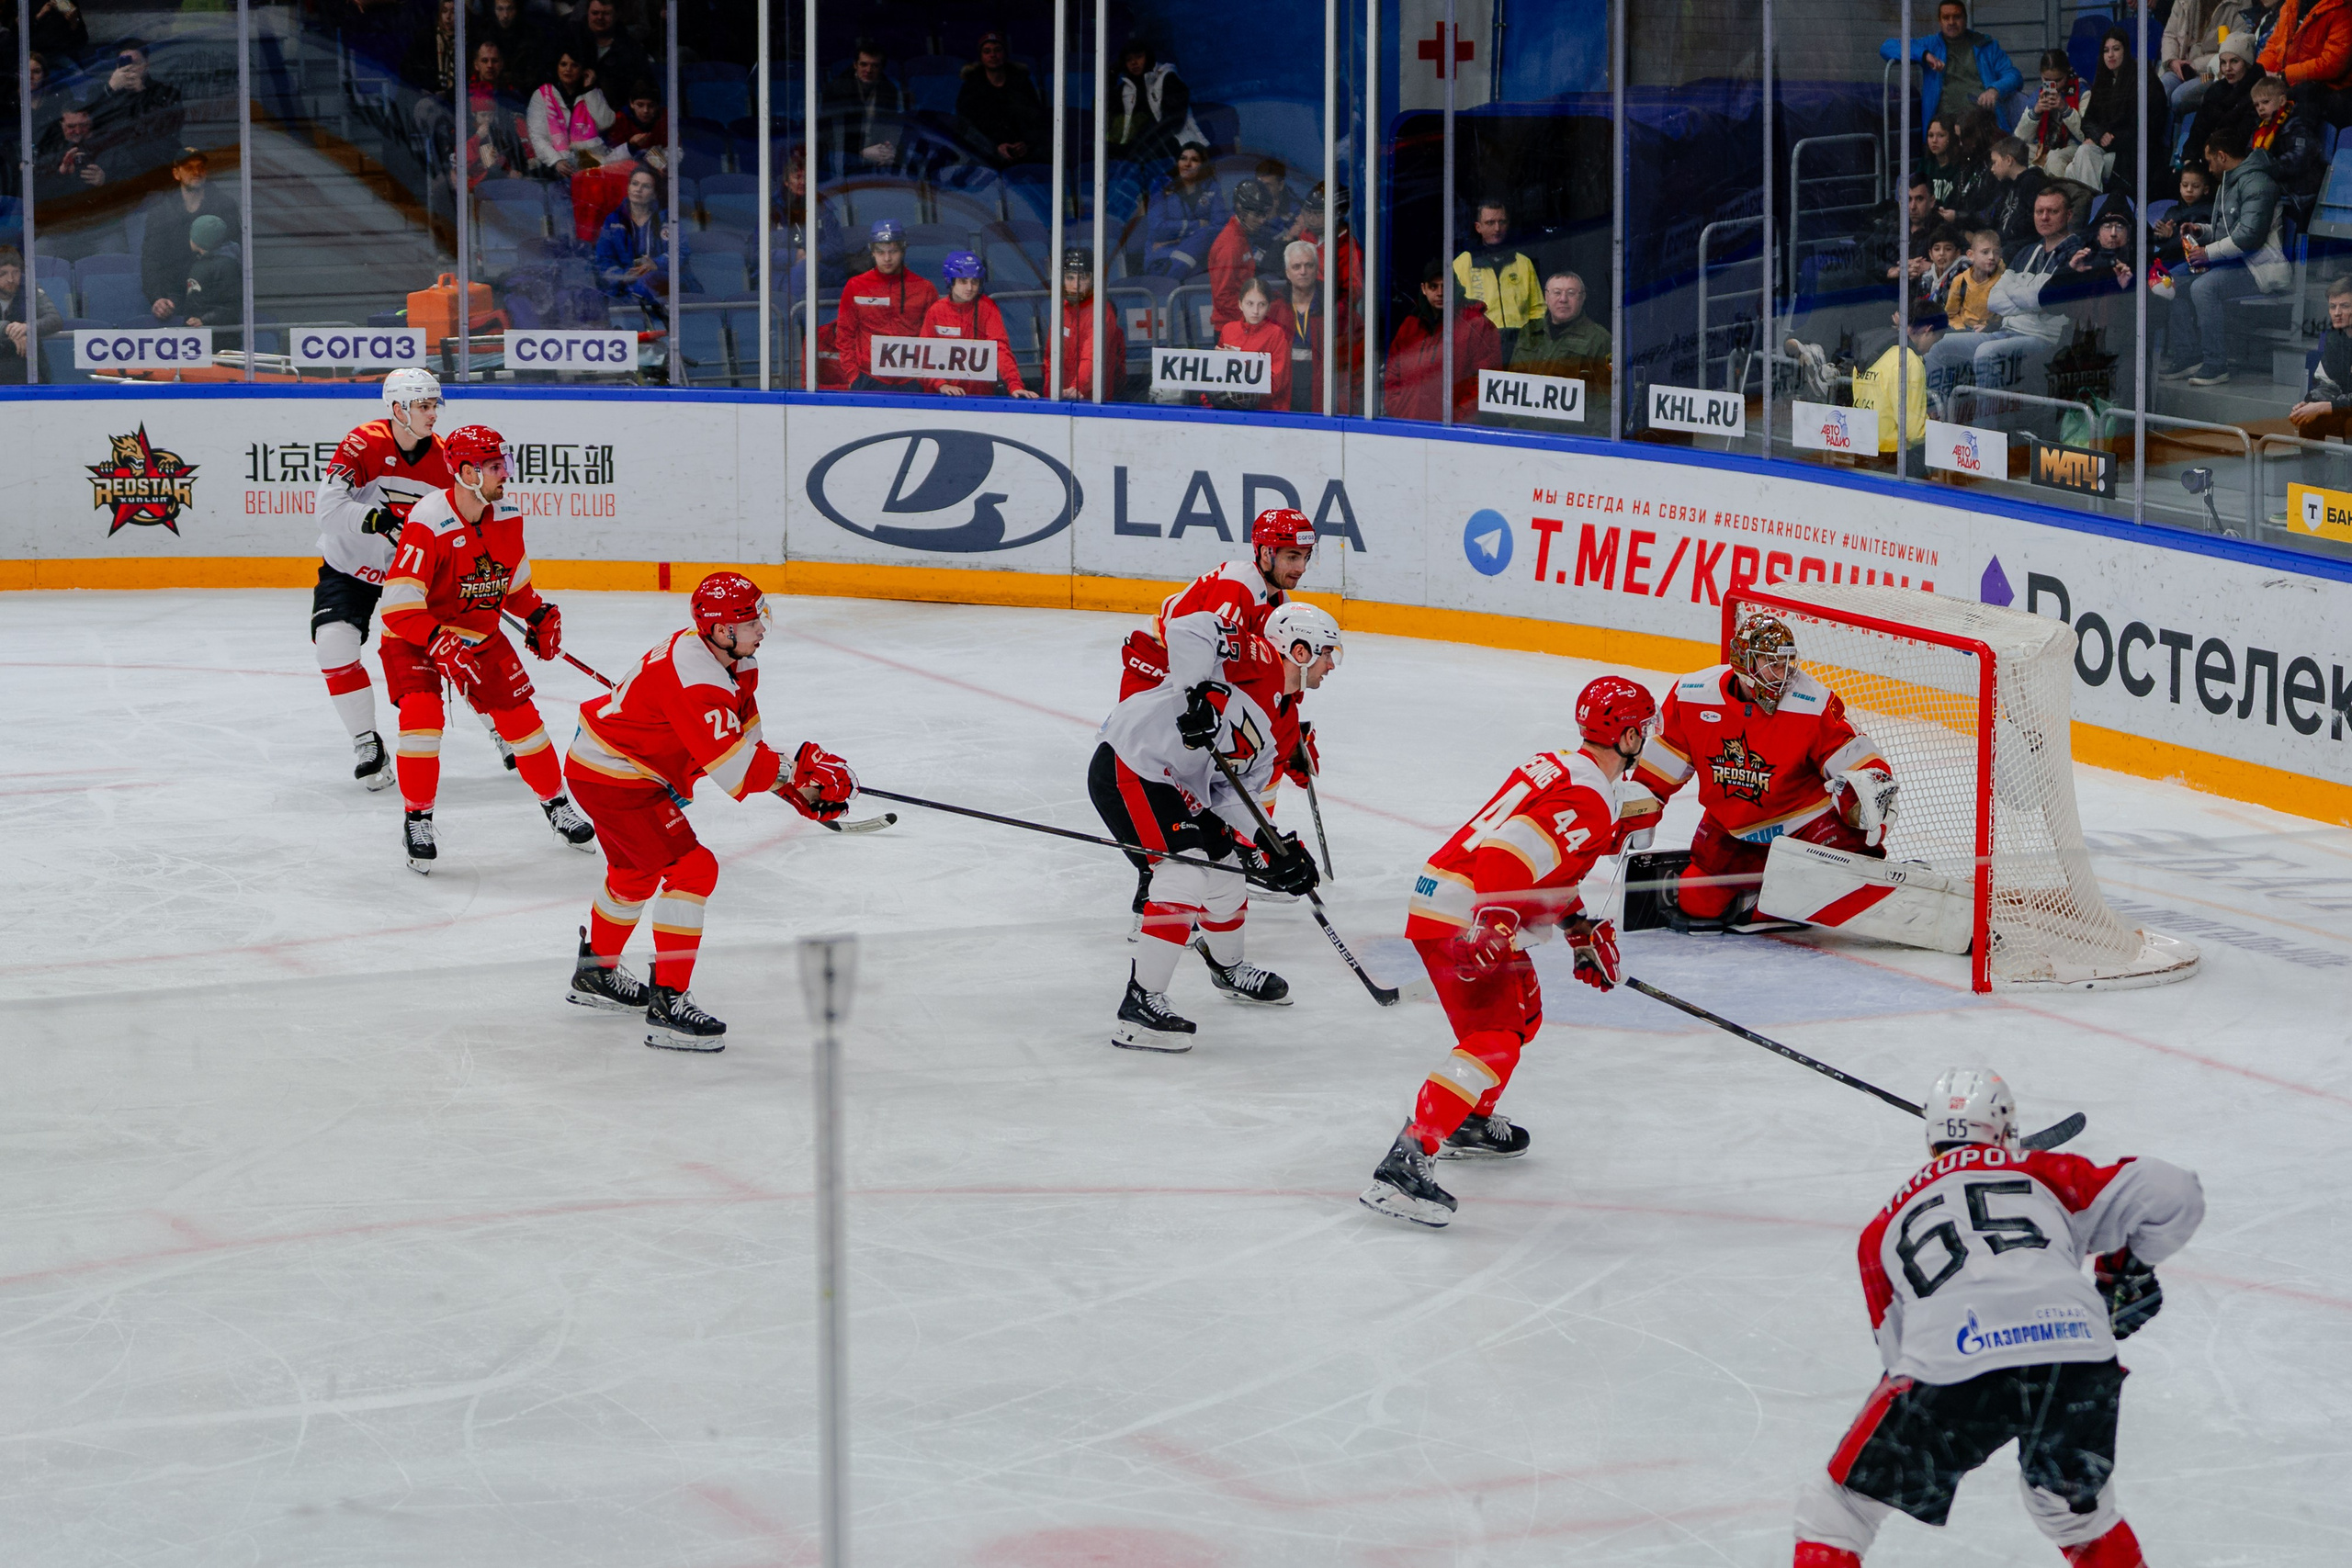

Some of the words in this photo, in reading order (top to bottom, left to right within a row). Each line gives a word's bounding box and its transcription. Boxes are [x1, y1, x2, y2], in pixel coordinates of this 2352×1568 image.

[879, 343, 989, 372] KHL.RU
[1159, 355, 1264, 386] KHL.RU
[1486, 378, 1578, 412] KHL.RU
[1655, 393, 1739, 427] KHL.RU
[1821, 423, 1839, 436] АВТО
[1826, 435, 1850, 447] РАДИО
[1952, 445, 1971, 457] АВТО
[1957, 457, 1981, 470] РАДИО
[327, 463, 356, 491] 74
[2040, 446, 2106, 492] МАТЧ!
[89, 477, 198, 510] REDSTAR
[245, 491, 316, 514] BEIJING
[571, 493, 616, 517] CLUB
[1114, 466, 1367, 553] LADA
[1532, 488, 1557, 504] МЫ
[1566, 491, 1623, 513] ВСЕГДА
[1633, 500, 1650, 516] НА
[1659, 503, 1707, 524] СВЯЗИ
[1714, 511, 1837, 546] #REDSTARHOCKEY
[1842, 533, 1939, 567] #UNITEDWEWIN
[398, 543, 424, 574] 71
[355, 565, 387, 584] FON
[458, 576, 510, 599] REDSTAR
[1214, 621, 1240, 662] 13
[1128, 656, 1170, 678] CCM
[704, 706, 741, 740] 24
[1578, 705, 1590, 719] 44
[1711, 765, 1772, 794] REDSTAR
[1553, 808, 1592, 853] 44
[1323, 923, 1360, 970] BAUER
[1947, 1118, 1968, 1138] 65
[1883, 1148, 2030, 1214] YAKUPOV
[1895, 1179, 2052, 1299] 65
